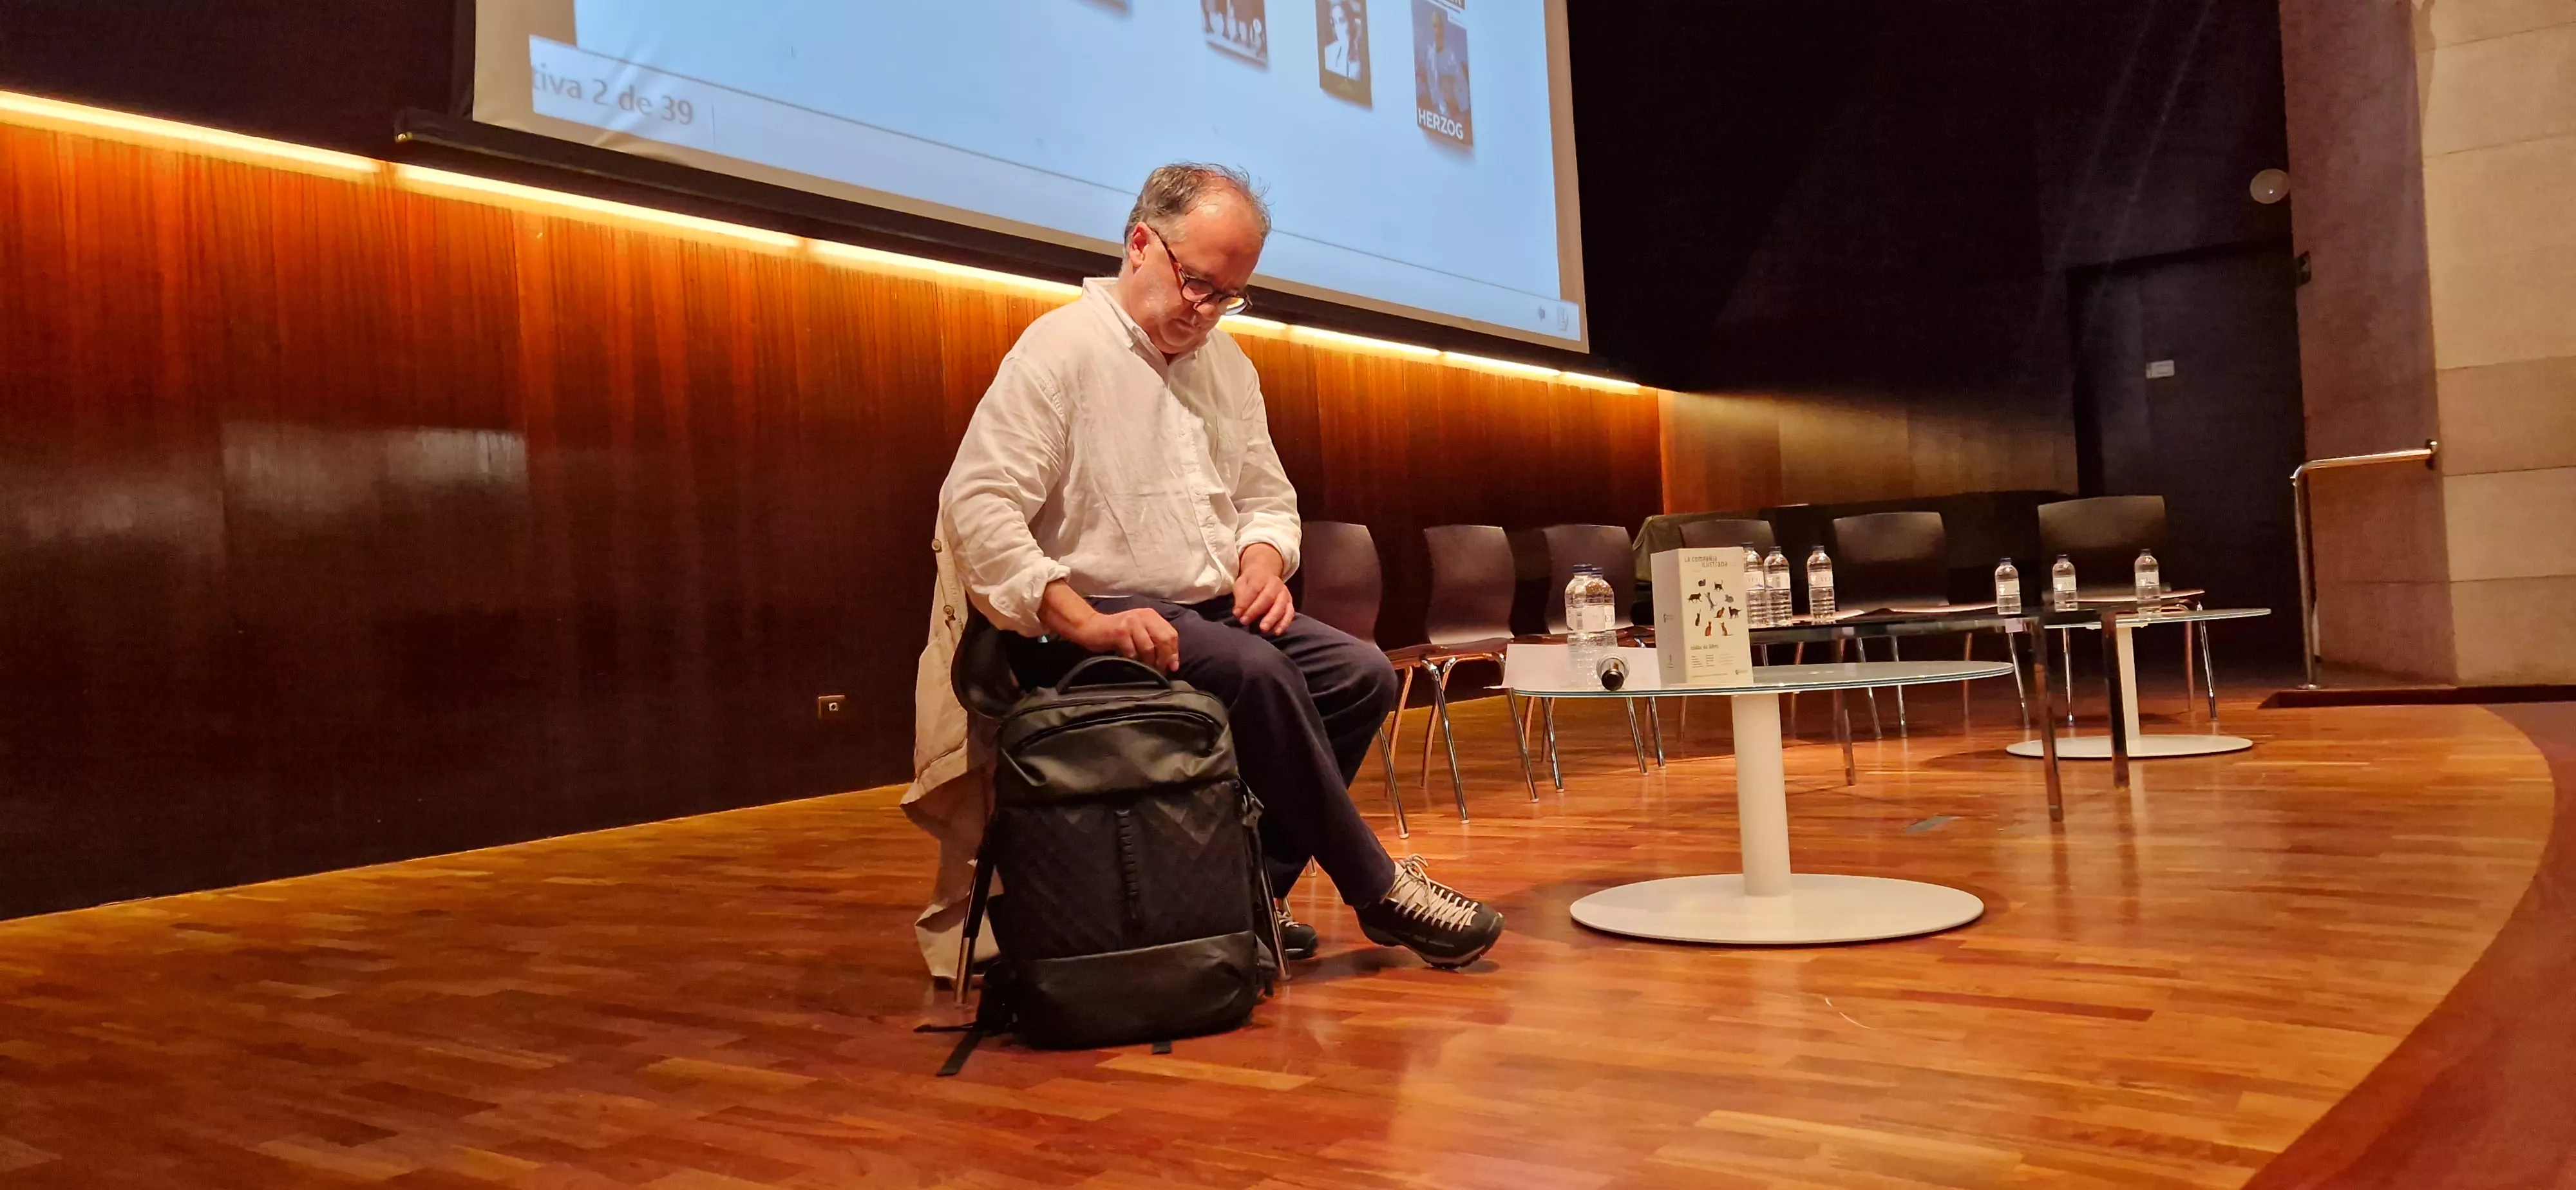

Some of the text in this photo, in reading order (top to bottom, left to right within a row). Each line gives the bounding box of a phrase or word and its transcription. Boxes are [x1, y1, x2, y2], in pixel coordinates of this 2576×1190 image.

[592, 78, 609, 106] 2
[618, 84, 652, 116] de
[661, 95, 694, 125] 39
[1418, 108, 1464, 140] HERZOG
